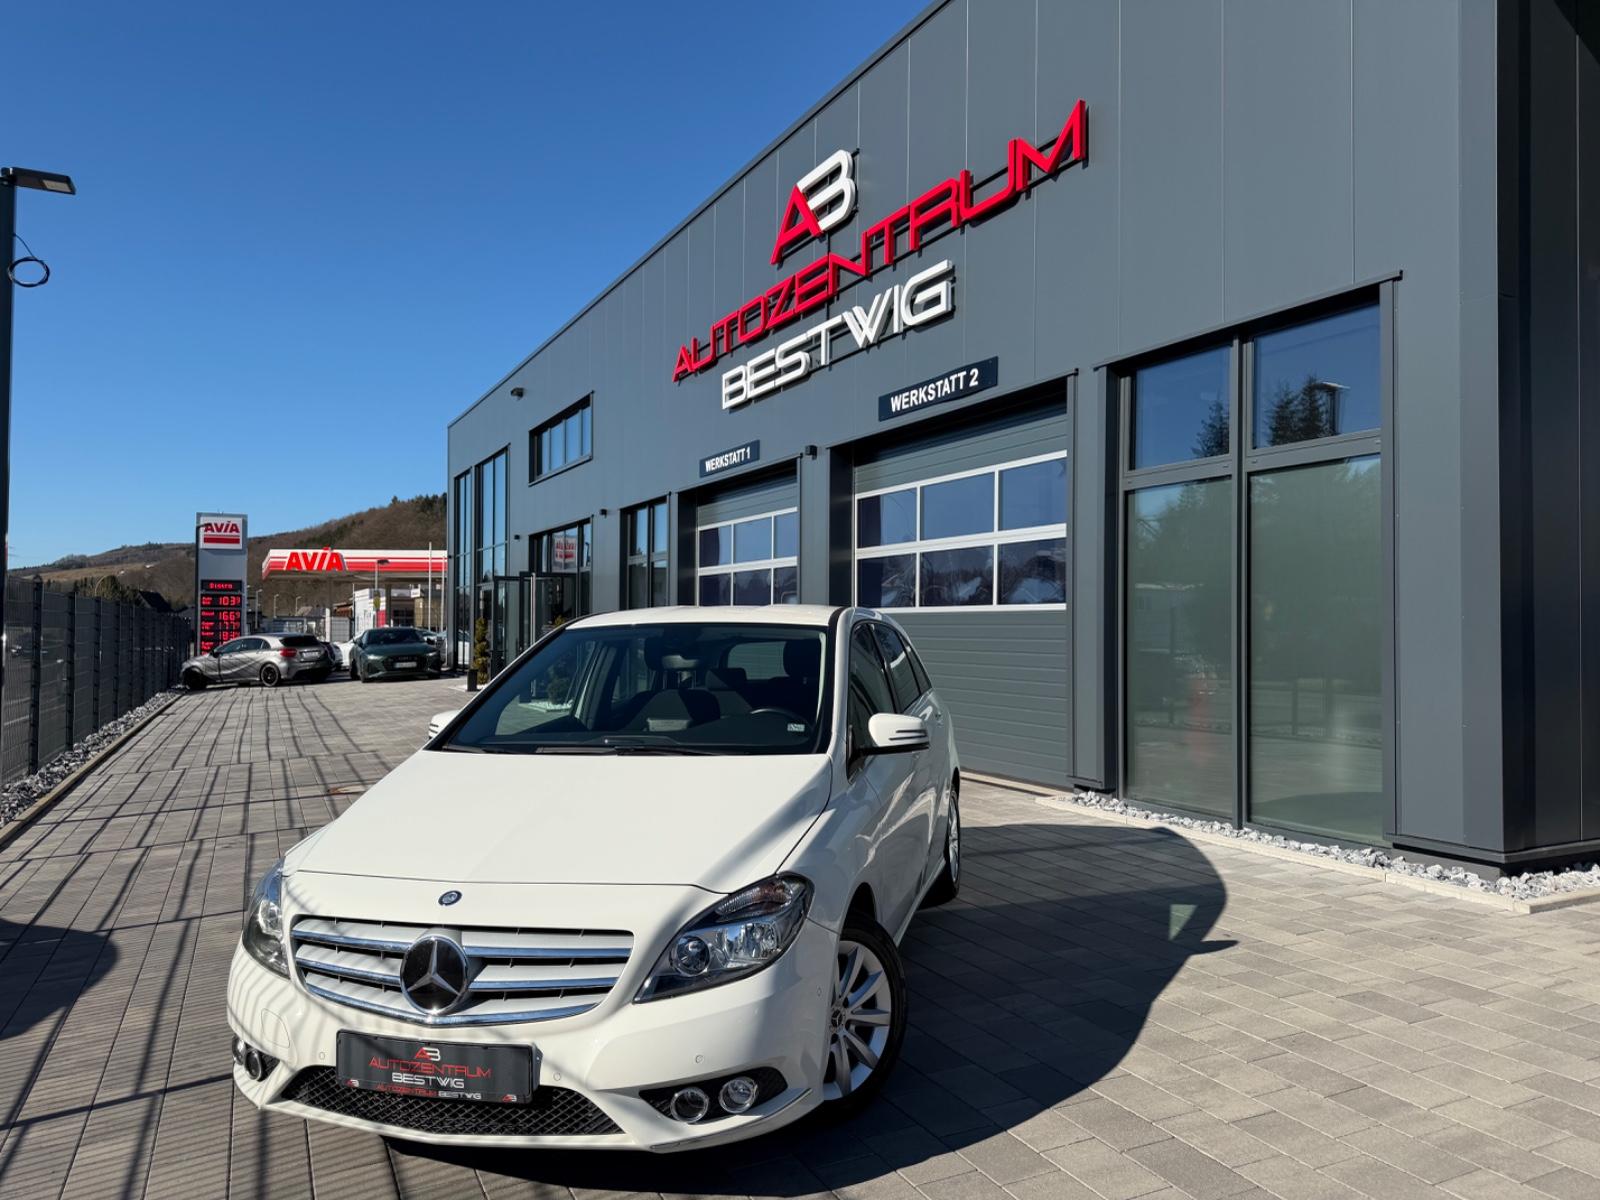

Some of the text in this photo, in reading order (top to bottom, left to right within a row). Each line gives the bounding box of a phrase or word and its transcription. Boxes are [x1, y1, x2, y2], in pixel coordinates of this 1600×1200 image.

[673, 98, 1087, 382] AUTOZENTRUM
[721, 259, 953, 410] BESTWIG
[890, 368, 979, 412] WERKSTATT 2
[705, 446, 751, 472] WERKSTATT 1
[368, 1056, 492, 1079] AUTOZENTRUM
[392, 1072, 465, 1089] BESTWIG
[376, 1083, 482, 1100] AUTOZENTRUM BESTWIG
